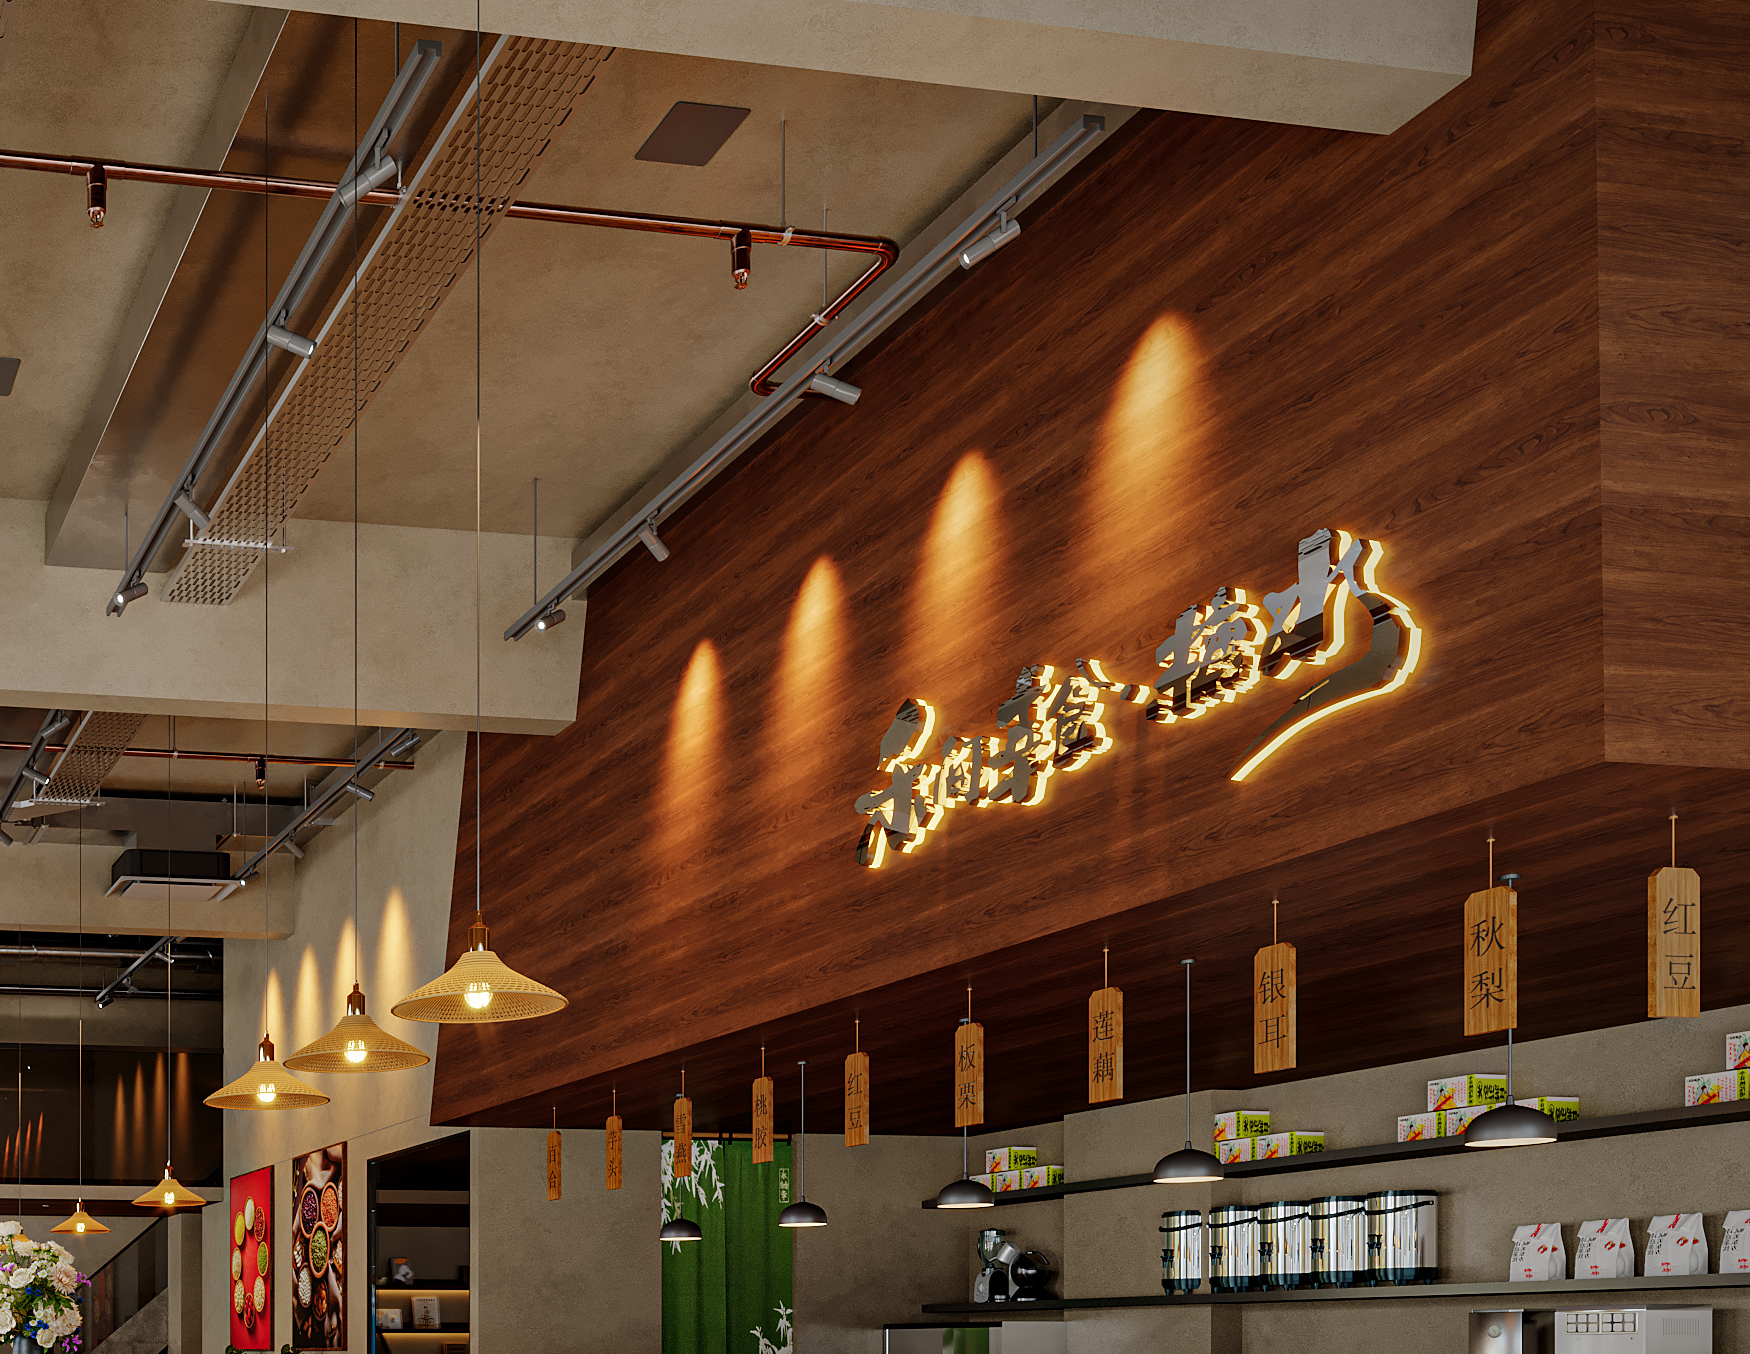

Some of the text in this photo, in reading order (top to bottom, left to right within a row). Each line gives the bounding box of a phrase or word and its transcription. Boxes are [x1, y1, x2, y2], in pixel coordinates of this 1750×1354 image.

[1469, 915, 1506, 1011] 秋梨
[1662, 897, 1697, 992] 红豆
[1258, 967, 1288, 1049] 银耳
[957, 1042, 978, 1111] 板栗
[1091, 1009, 1116, 1085] 莲藕
[753, 1092, 769, 1150] 桃胶
[846, 1071, 864, 1133] 红豆
[547, 1144, 559, 1192] 百合
[606, 1127, 619, 1180] 芋头
[674, 1111, 689, 1167] 雪燕
